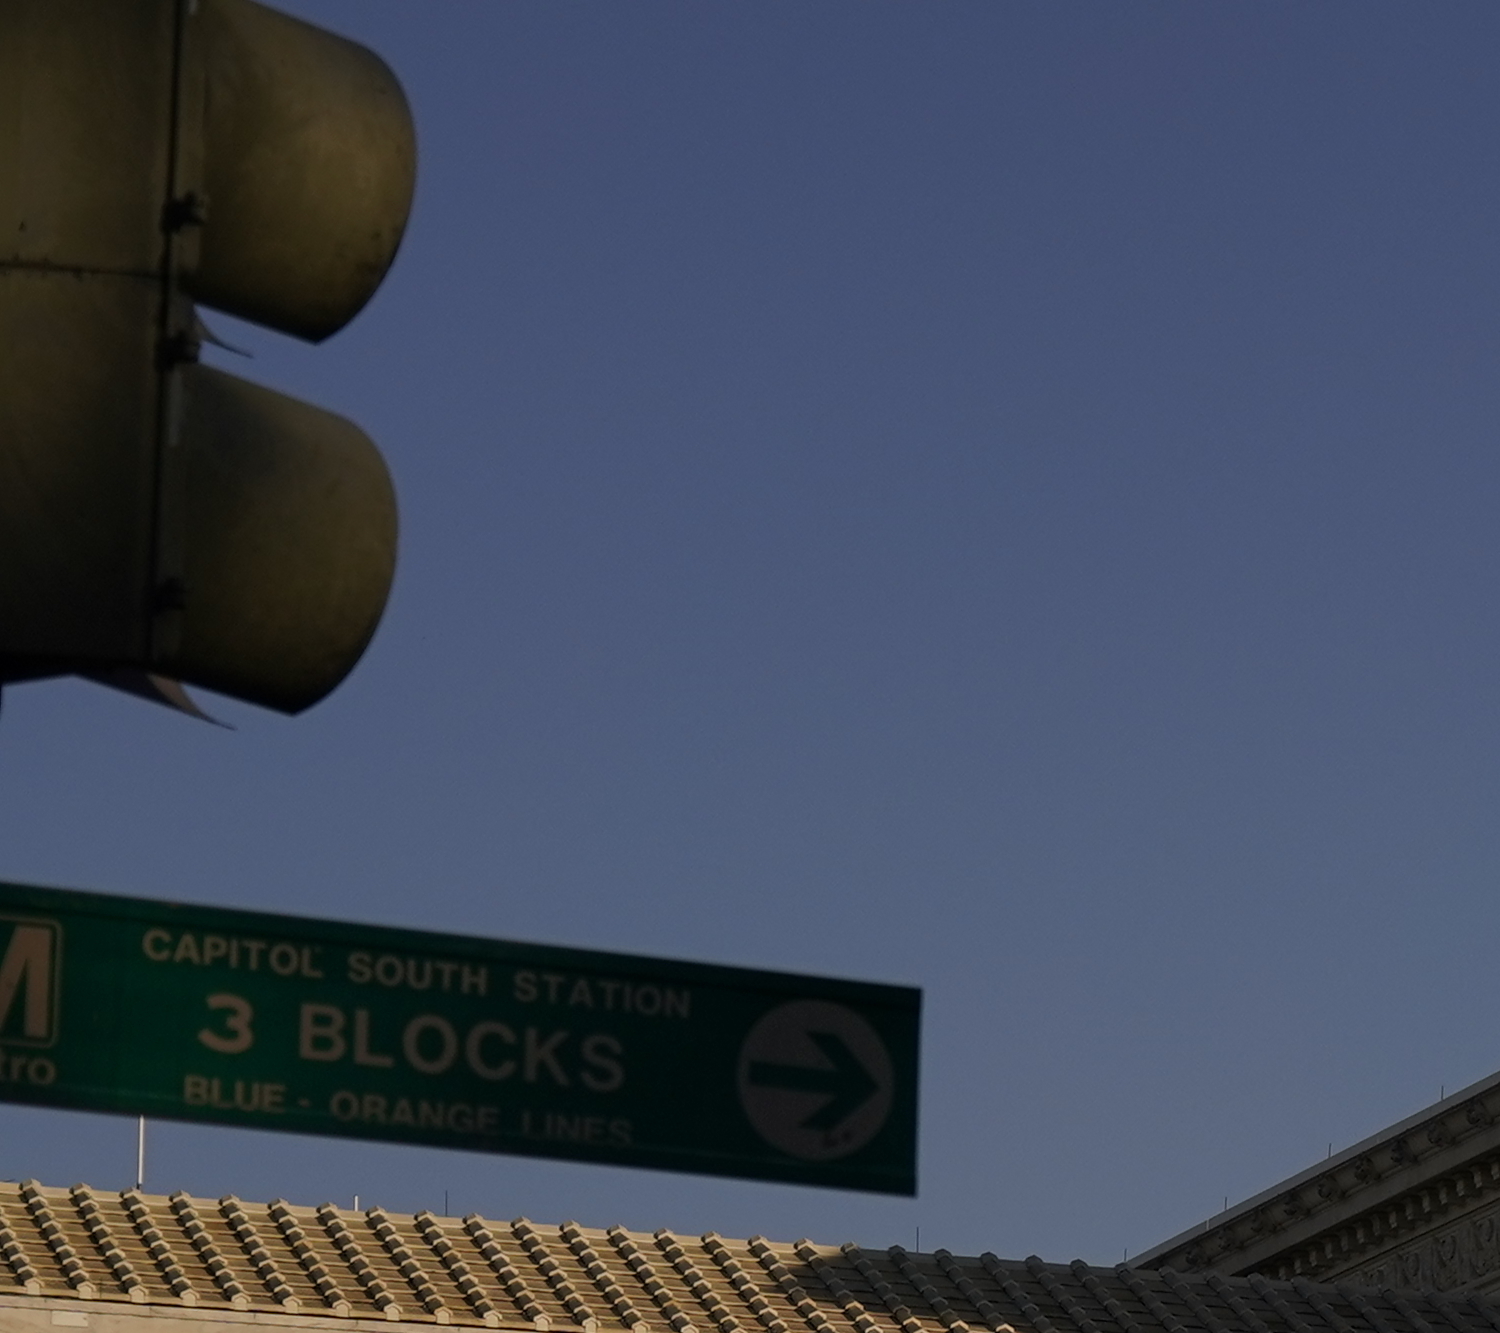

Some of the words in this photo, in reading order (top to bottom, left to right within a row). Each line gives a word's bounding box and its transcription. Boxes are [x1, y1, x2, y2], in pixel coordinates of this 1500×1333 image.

[142, 926, 325, 979] CAPITOL
[347, 951, 489, 997] SOUTH
[512, 969, 692, 1020] STATION
[0, 1054, 58, 1086] tro
[198, 992, 254, 1054] 3
[298, 1002, 626, 1093] BLOCKS
[183, 1073, 288, 1115] BLUE
[328, 1090, 500, 1134] ORANGE
[519, 1109, 633, 1148] LINES
